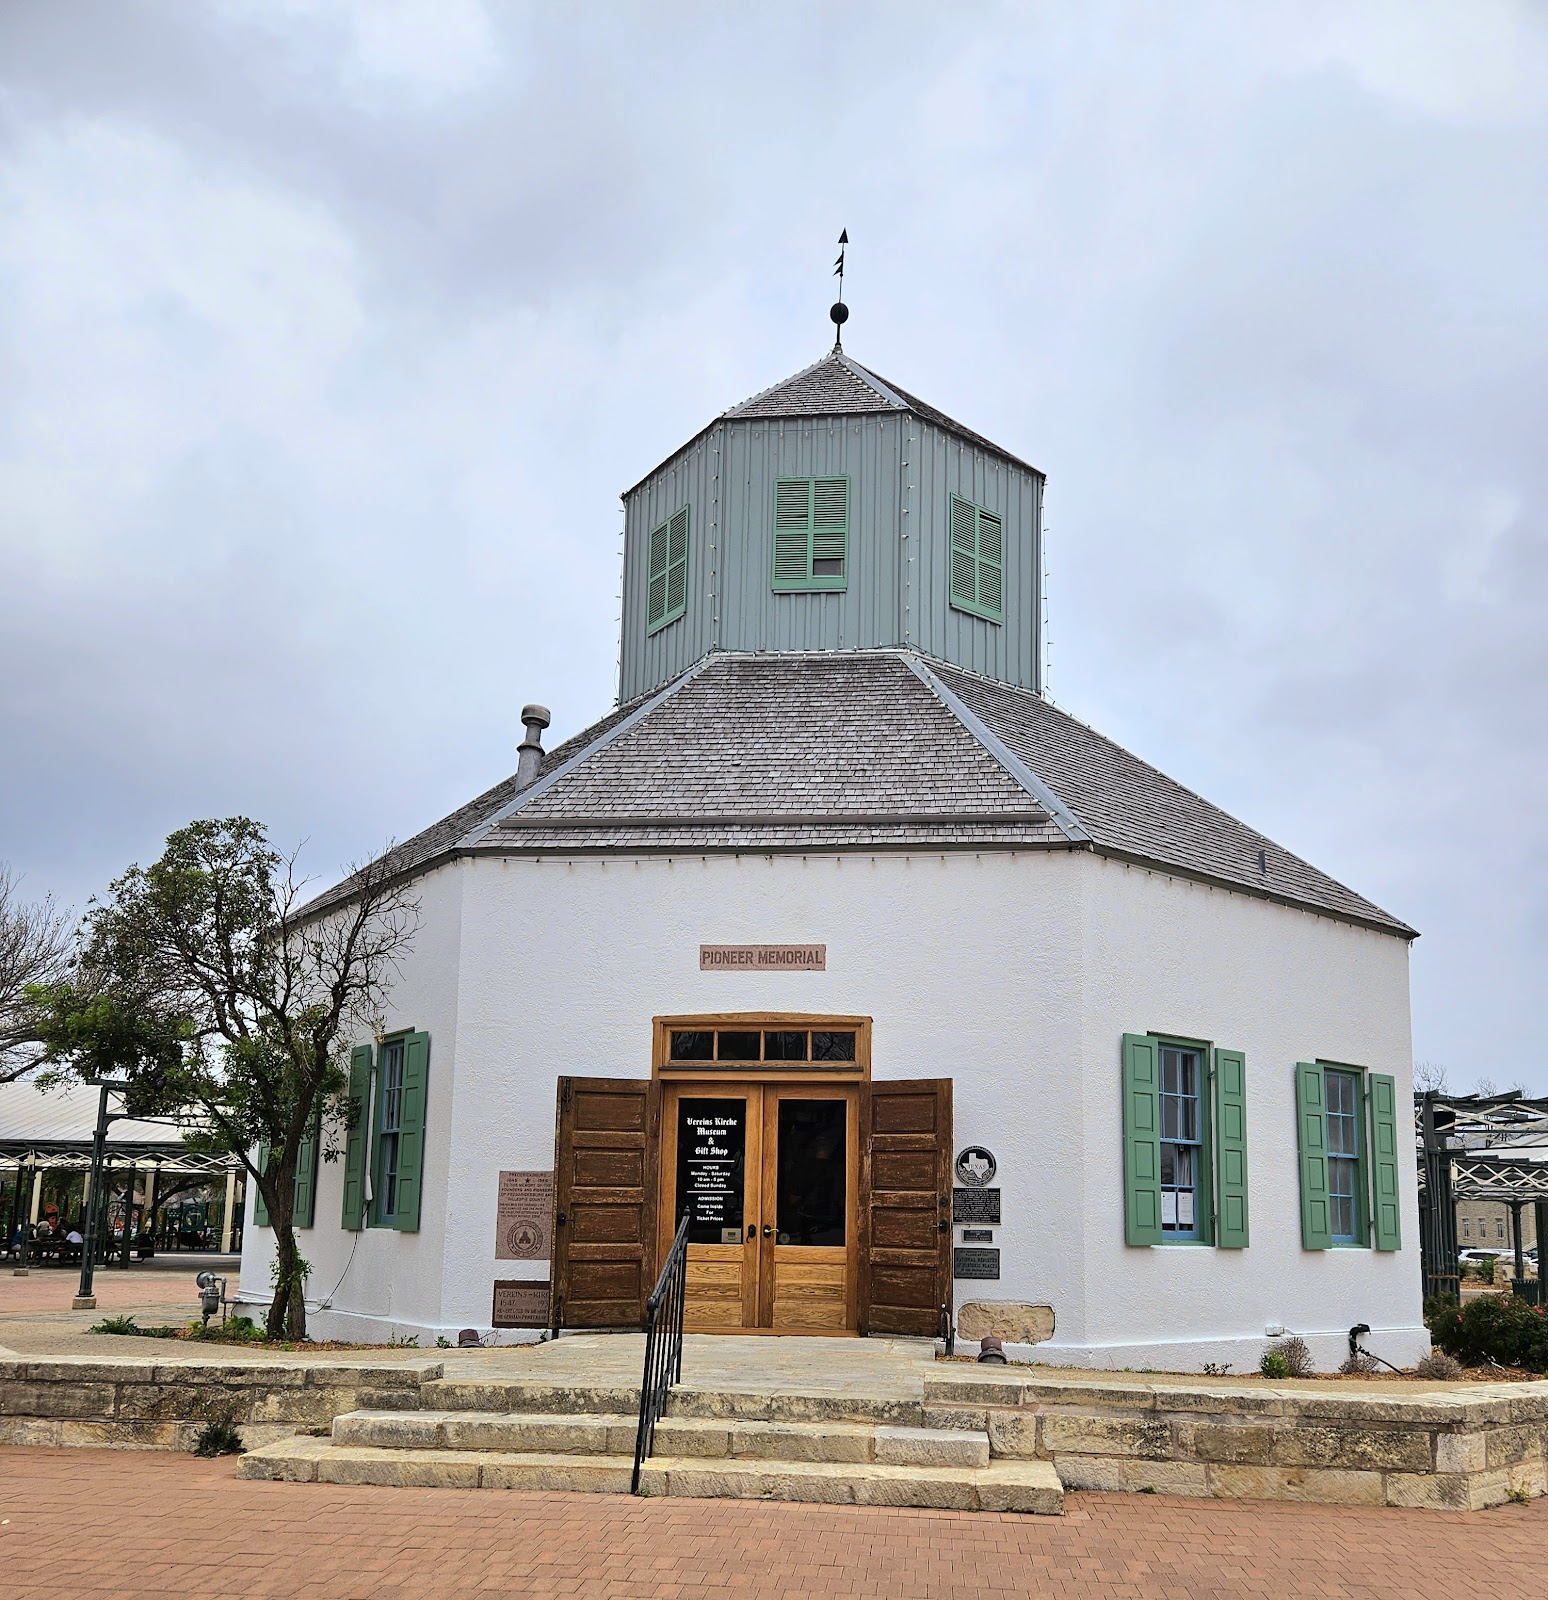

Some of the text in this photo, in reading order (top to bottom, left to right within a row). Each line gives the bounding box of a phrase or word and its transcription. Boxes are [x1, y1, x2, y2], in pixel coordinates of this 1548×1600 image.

[702, 950, 822, 964] PIONEER MEMORIAL
[686, 1117, 738, 1126] Vereins Kirche
[696, 1126, 726, 1136] Museum
[708, 1136, 714, 1145] &
[695, 1146, 728, 1156] Gift Shop
